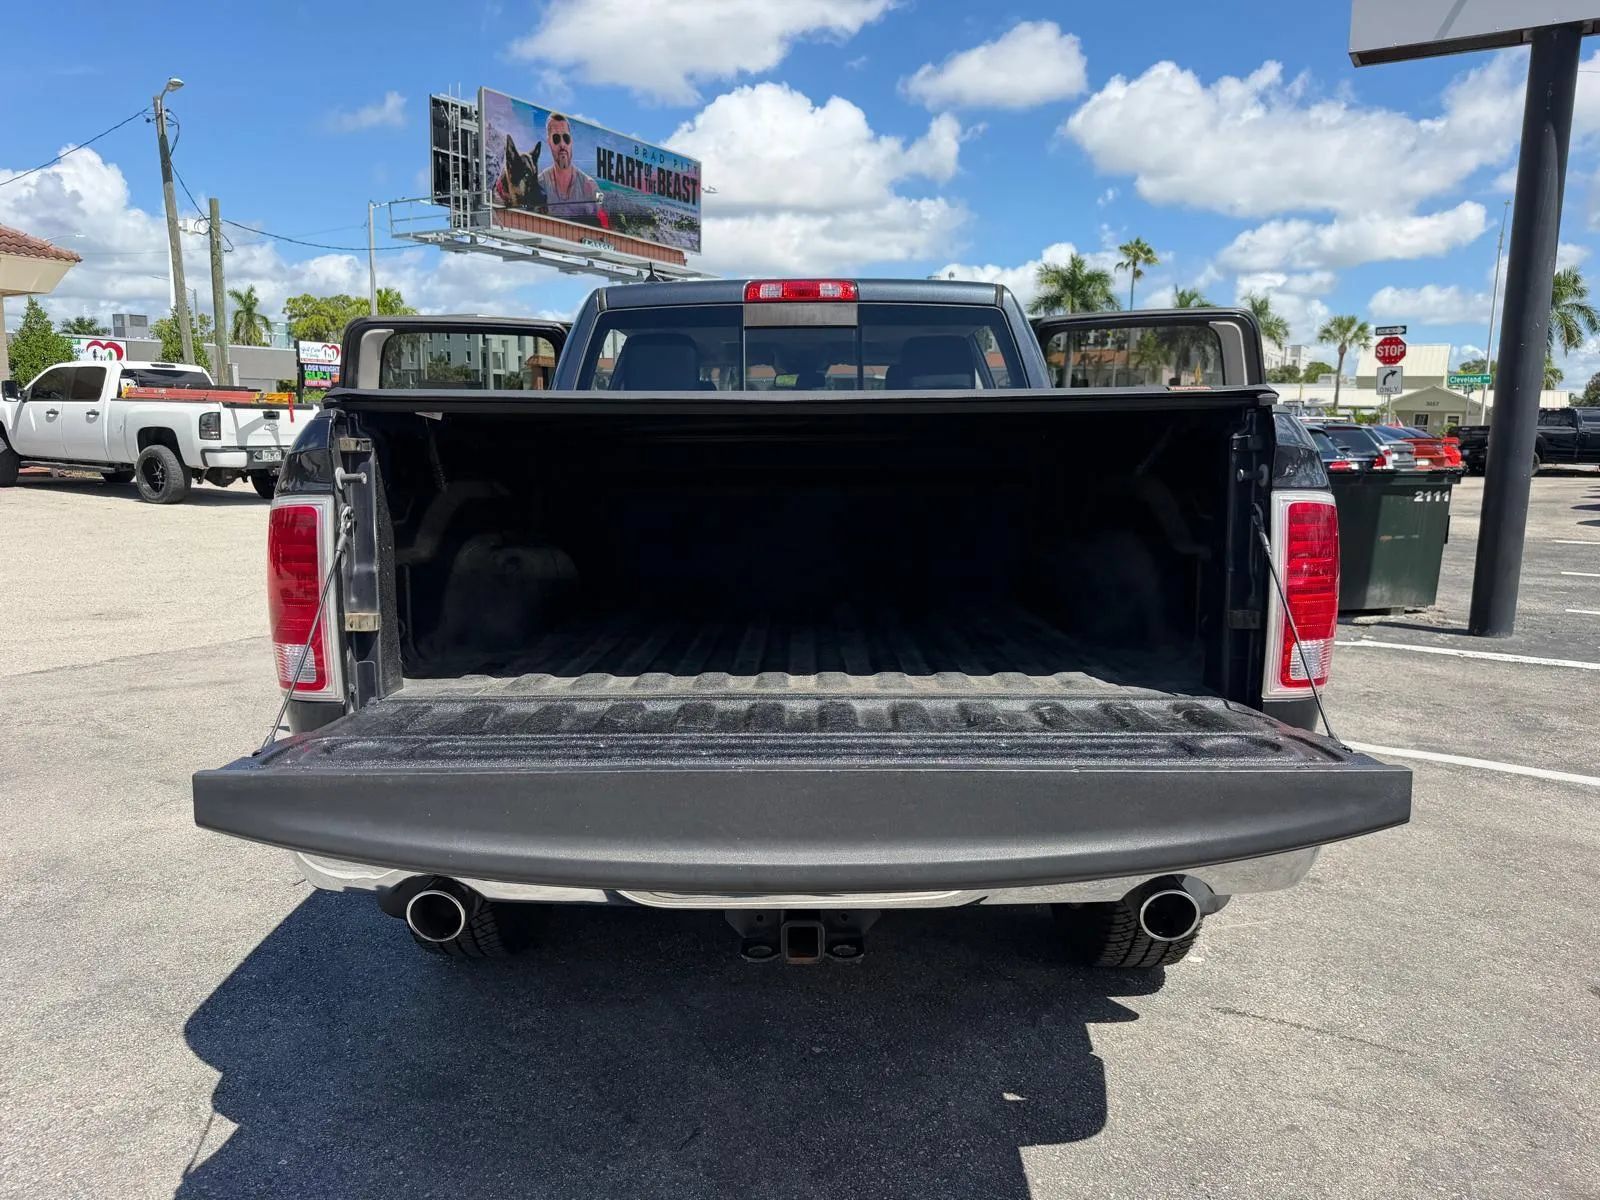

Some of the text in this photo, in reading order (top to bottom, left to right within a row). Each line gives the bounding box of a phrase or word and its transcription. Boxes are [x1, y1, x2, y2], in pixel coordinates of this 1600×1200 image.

[634, 145, 698, 175] BRAD PITT
[596, 146, 697, 205] HEART OF THE BEAST
[1376, 345, 1405, 357] STOP
[304, 364, 340, 373] LOSE WEIGHT
[305, 371, 331, 380] GLP-1
[1450, 375, 1481, 383] Cleveland
[1380, 385, 1399, 393] ONLY
[1413, 490, 1450, 502] 2111
